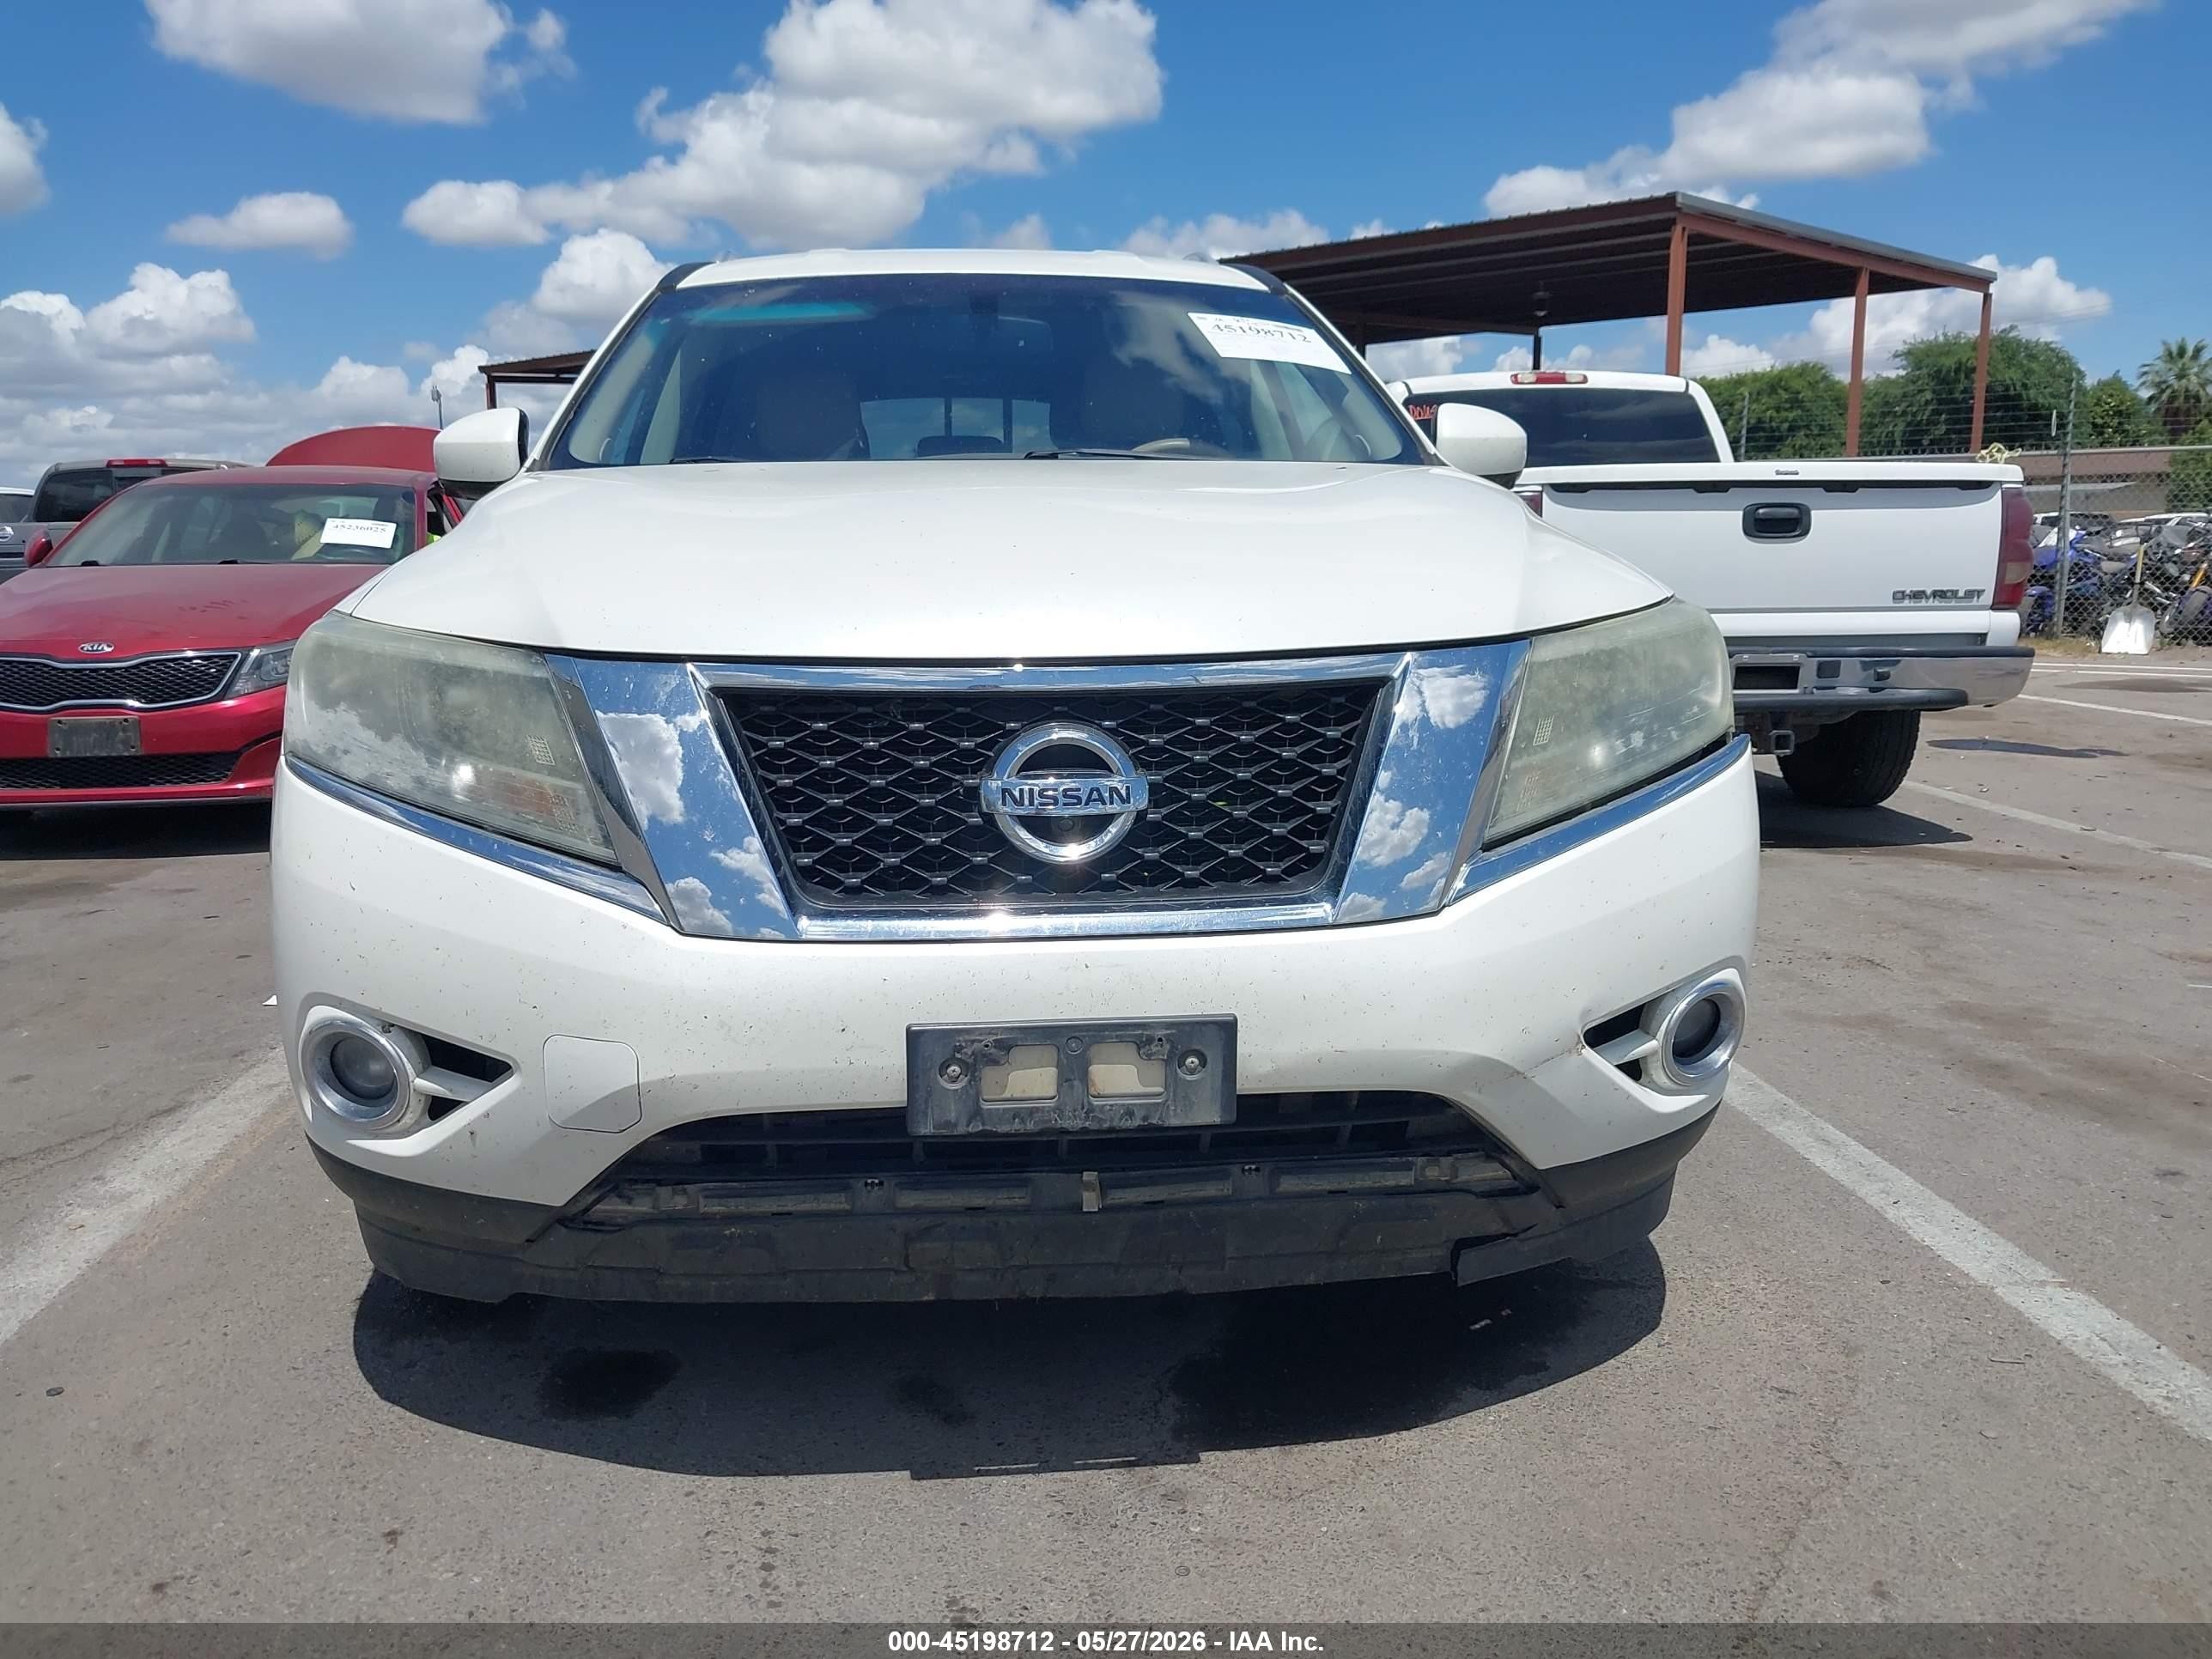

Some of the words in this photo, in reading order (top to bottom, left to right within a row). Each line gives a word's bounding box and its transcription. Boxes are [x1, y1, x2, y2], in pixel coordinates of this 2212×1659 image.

[1212, 323, 1312, 343] 45198712
[1892, 588, 1986, 602] CHEVROLET
[82, 643, 109, 652] KIA
[1000, 784, 1132, 808] NISSAN
